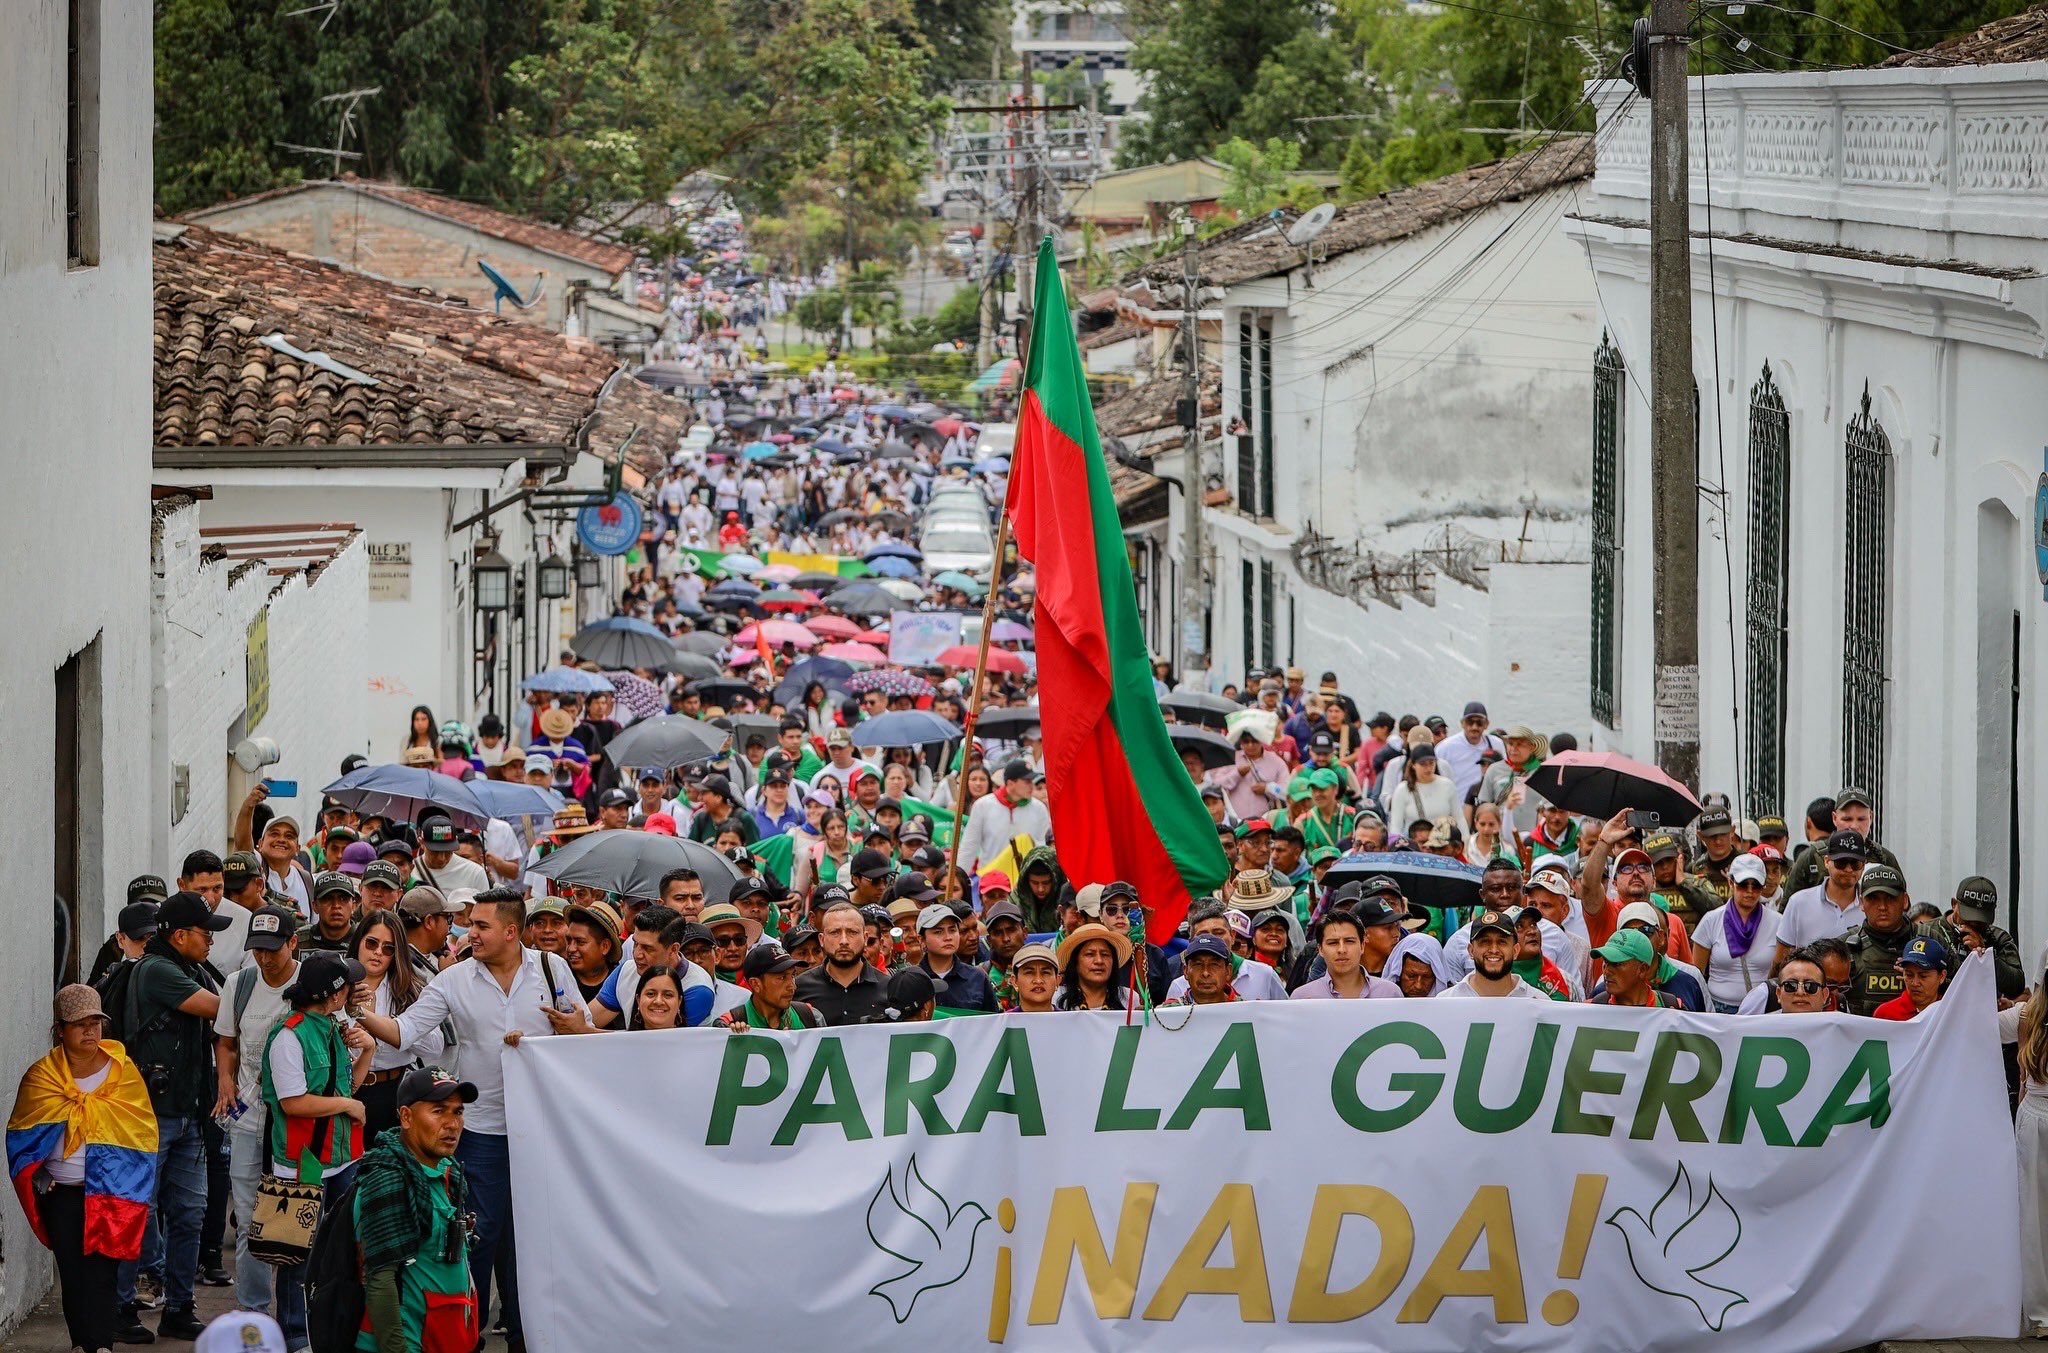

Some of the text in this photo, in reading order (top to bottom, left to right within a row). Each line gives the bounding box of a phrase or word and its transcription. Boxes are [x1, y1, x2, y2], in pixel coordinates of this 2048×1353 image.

[1863, 870, 1898, 882] POLICÍA
[1963, 889, 1996, 903] POLICÍA
[705, 1021, 1892, 1148] PARA LA GUERRA
[988, 1173, 1608, 1344] ¡NADA!
